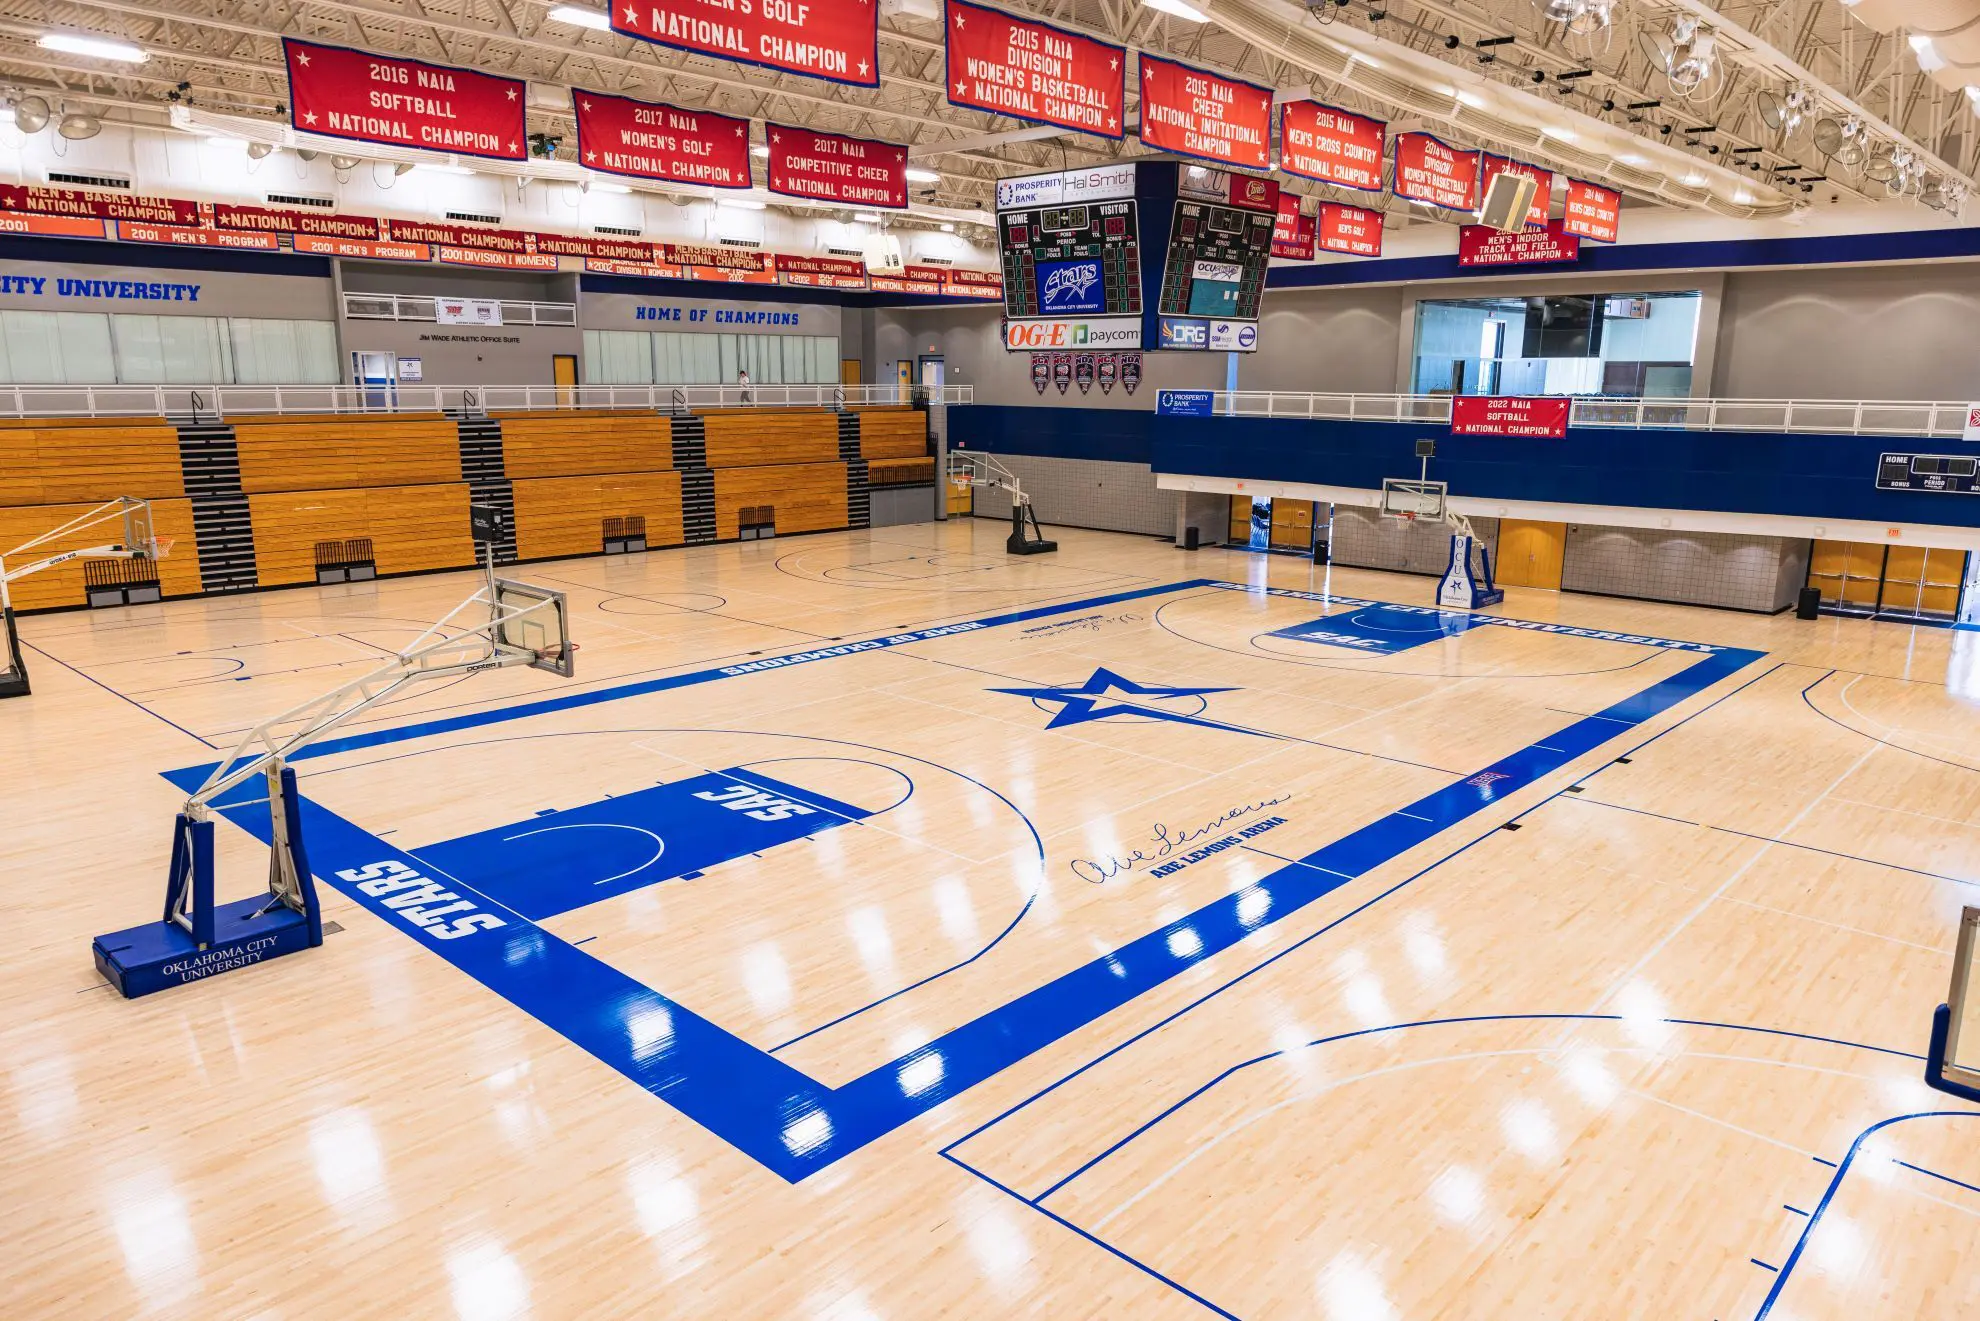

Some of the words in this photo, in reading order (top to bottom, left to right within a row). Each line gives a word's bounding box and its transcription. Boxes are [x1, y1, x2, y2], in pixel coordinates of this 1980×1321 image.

[762, 0, 809, 27] GOLF
[652, 7, 750, 53] NATIONAL
[759, 34, 847, 74] CHAMPION
[1009, 25, 1039, 50] 2015
[1045, 34, 1073, 61] NAIA
[1007, 46, 1063, 76] DIVISION
[1067, 62, 1072, 79] I
[369, 63, 409, 85] 2016
[417, 69, 456, 93] NAIA
[967, 57, 1025, 89] WOMEN'S
[1032, 76, 1109, 110] BASKETBALL
[1185, 76, 1208, 97] 2015
[1211, 83, 1234, 104] NAIA
[369, 91, 457, 119] SOFTBALL
[975, 83, 1039, 113] NATIONAL
[1045, 99, 1102, 127] CHAMPION
[1192, 99, 1224, 120] CHEER
[328, 111, 413, 140] NATIONAL
[421, 126, 499, 151] CHAMPION
[634, 108, 663, 127] 2017
[669, 113, 698, 133] NAIA
[1149, 102, 1197, 132] NATIONAL
[1201, 117, 1262, 145] INVITATIONAL
[1316, 111, 1335, 129] 2015
[1337, 116, 1355, 135] NAIA
[620, 129, 677, 151] WOMEN'S
[682, 139, 713, 157] GOLF
[814, 138, 838, 155] 2017
[842, 142, 866, 159] NAIA
[1185, 131, 1231, 157] CHAMPION
[1289, 127, 1313, 148] MEN'S
[1316, 132, 1342, 153] CROSS
[1344, 140, 1377, 162] COUNTRY
[603, 151, 666, 175] NATIONAL
[672, 161, 731, 183] CHAMPION
[786, 155, 853, 177] COMPETITIVE
[857, 165, 889, 182] CHEER
[1294, 154, 1331, 177] NATIONAL
[1334, 162, 1370, 185] CHAMPION
[1404, 166, 1432, 185] WOMEN'S
[1424, 155, 1451, 176] DIVISION
[787, 176, 838, 197] NATIONAL
[842, 184, 890, 203] CHAMPION
[1015, 178, 1062, 191] PROSPERITY
[1406, 182, 1435, 200] NATIONAL
[1436, 189, 1464, 208] CHAMPION
[28, 184, 75, 200] MEN'S
[84, 190, 173, 210] BASKETBALL
[1015, 193, 1037, 203] BANK
[26, 197, 97, 215] NATIONAL
[108, 204, 177, 222] CHAMPION
[1006, 213, 1029, 225] HOME
[1100, 203, 1129, 216] VISITOR
[1182, 204, 1200, 217] HOME
[1252, 215, 1272, 227] VISITOR
[0, 219, 29, 232] 2001
[230, 212, 298, 231] NATIONAL
[301, 218, 366, 237] CHAMPION
[131, 228, 159, 241] 2001
[171, 232, 207, 244] MEN'S
[218, 235, 268, 248] PROGRAM
[402, 227, 457, 244] NATIONAL
[461, 233, 515, 250] CHAMPION
[1327, 237, 1350, 250] NATIONAL
[1351, 240, 1373, 253] CHAMPION
[1478, 245, 1506, 255] TRACK
[1510, 243, 1528, 253] AND
[1531, 241, 1558, 252] FIELD
[1488, 236, 1513, 246] MEN'S
[1516, 232, 1549, 243] INDOOR
[311, 241, 334, 252] 2001
[339, 244, 368, 256] MEN'S
[375, 247, 417, 258] PROGRAM
[441, 248, 462, 260] 2001
[464, 250, 506, 265] DIVISION
[547, 239, 594, 255] NATIONAL
[596, 244, 644, 260] CHAMPION
[700, 246, 755, 261] BASKETBALL
[1473, 252, 1514, 264] NATIONAL
[1518, 249, 1562, 261] CHAMPION
[593, 261, 613, 272] 2002
[616, 266, 642, 276] DIVISION
[673, 253, 714, 266] NATIONAL
[716, 255, 757, 269] CHAMPION
[787, 260, 820, 272] NATIONAL
[822, 262, 852, 274] CHAMPION
[794, 274, 810, 285] 2002
[910, 270, 938, 280] CHAMPION
[960, 271, 987, 283] NATIONAL
[1044, 264, 1098, 301] Stars
[0, 275, 47, 295] ITY
[57, 278, 201, 302] UNIVERSITY
[877, 280, 904, 292] NATIONAL
[905, 282, 934, 293] CHAMPION
[947, 285, 971, 295] NATIONAL
[971, 287, 996, 297] CHAMPION
[636, 306, 682, 321] HOME
[689, 309, 708, 322] OF
[715, 310, 799, 325] CHAMPIONS
[419, 334, 430, 342] JIM
[431, 334, 450, 342] WADE
[451, 335, 480, 343] ATHLETIC
[480, 335, 502, 343] OFFICE
[503, 336, 521, 344] SUITE
[1090, 329, 1138, 344] paycom
[1487, 400, 1508, 408] 2022
[1511, 400, 1531, 409] NAIA
[1487, 412, 1530, 422] SOFTBALL
[1465, 424, 1504, 433] NATIONAL
[1507, 425, 1550, 435] CHAMPION
[1885, 455, 1909, 464] HOME
[1208, 581, 1378, 608] OKLAHOMA
[1378, 603, 1469, 618] CITY
[1469, 615, 1727, 653] UNIVERSITY
[888, 633, 916, 646] OF
[918, 621, 988, 639] HOME
[1300, 631, 1389, 648] SAC
[718, 641, 885, 677] CHAMPIONS
[690, 784, 819, 822] SAC
[1149, 858, 1186, 879] ABE
[1183, 835, 1244, 866] LEMONS
[1238, 815, 1289, 840] ARENA
[335, 859, 508, 941] STARS
[163, 944, 243, 976] OKLAHOMA
[246, 935, 279, 953] CITY
[181, 950, 264, 983] UNIVERSITY
